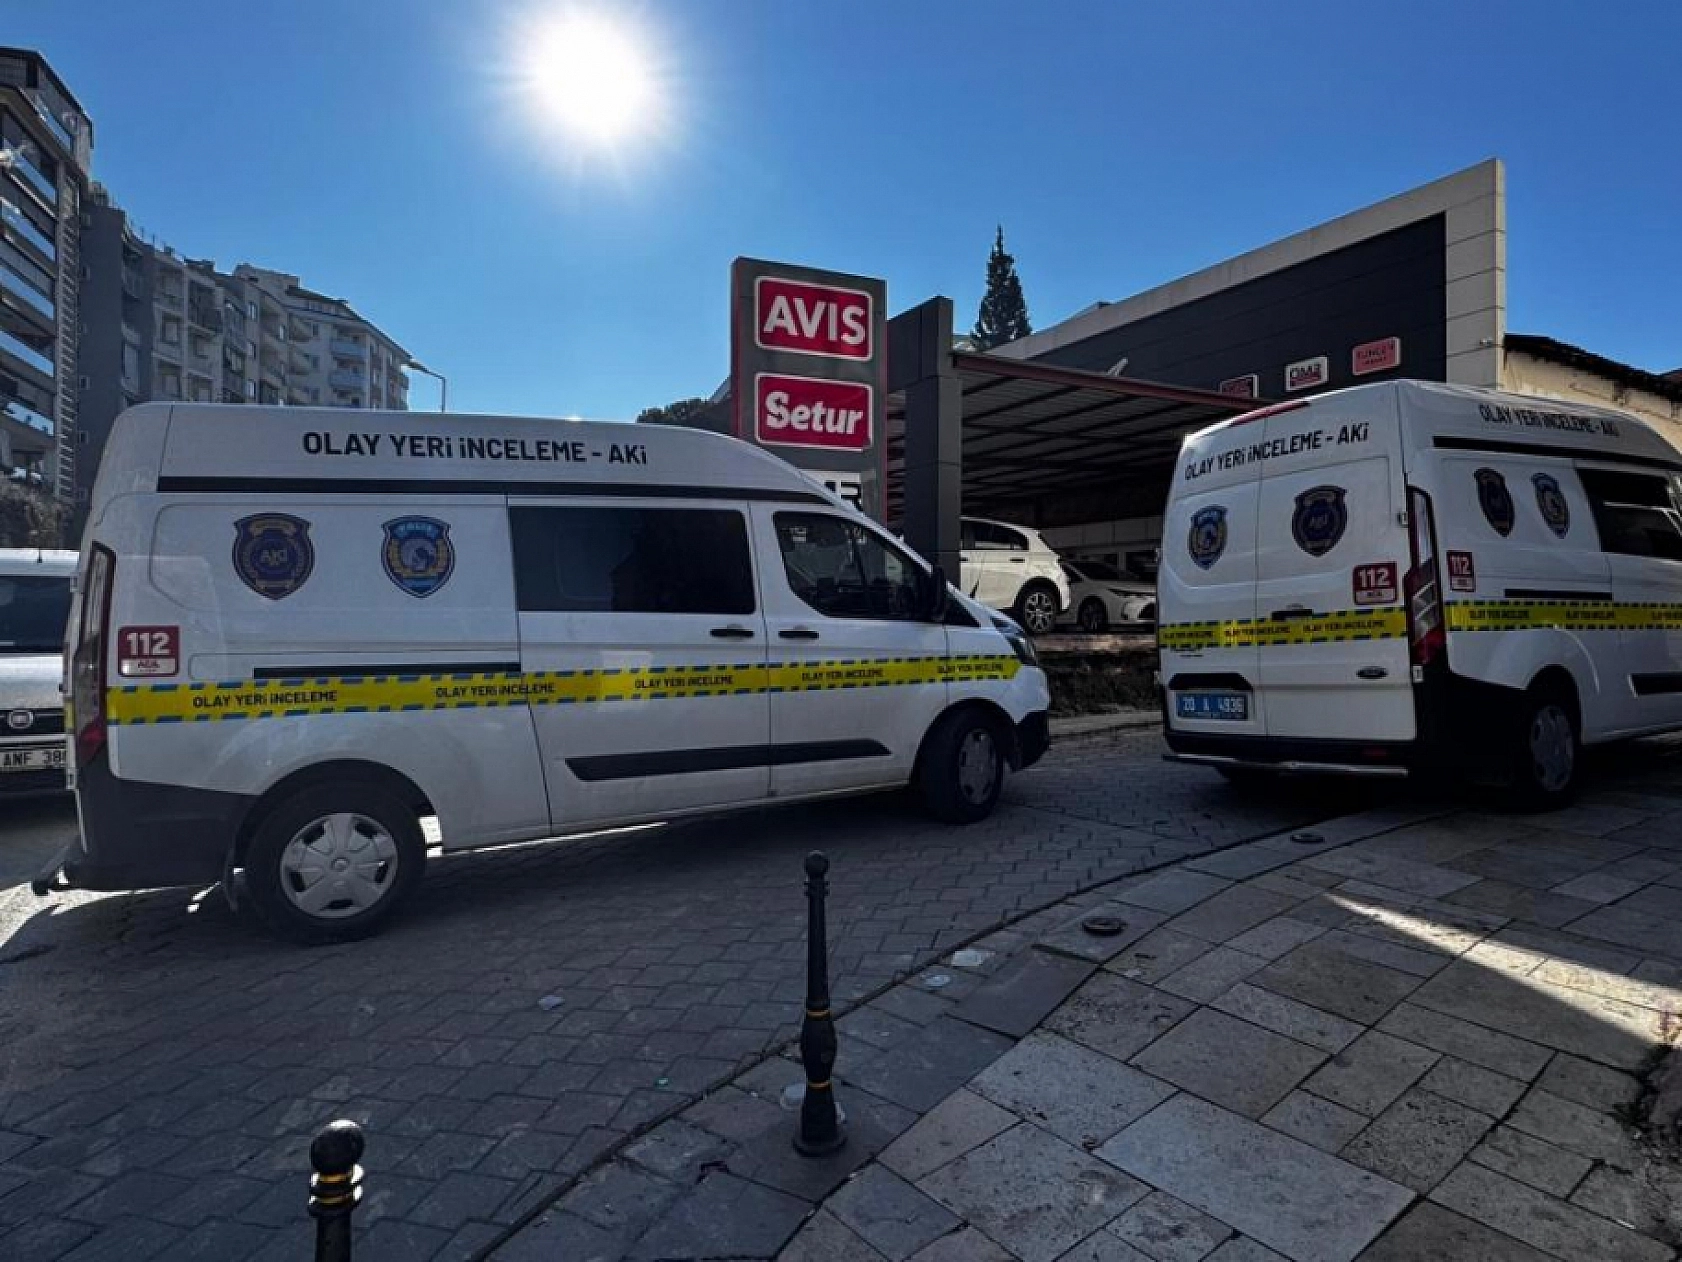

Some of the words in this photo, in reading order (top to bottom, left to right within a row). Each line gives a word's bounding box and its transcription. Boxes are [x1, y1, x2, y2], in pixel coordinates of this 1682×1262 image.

[763, 295, 866, 345] AVIS
[765, 391, 864, 435] Setur
[303, 432, 381, 456] OLAY
[1185, 457, 1213, 481] OLAY
[1358, 567, 1390, 588] 112
[127, 632, 170, 656] 112
[192, 694, 231, 708] OLAY
[435, 685, 467, 697] OLAY
[4, 751, 33, 766] ANF
